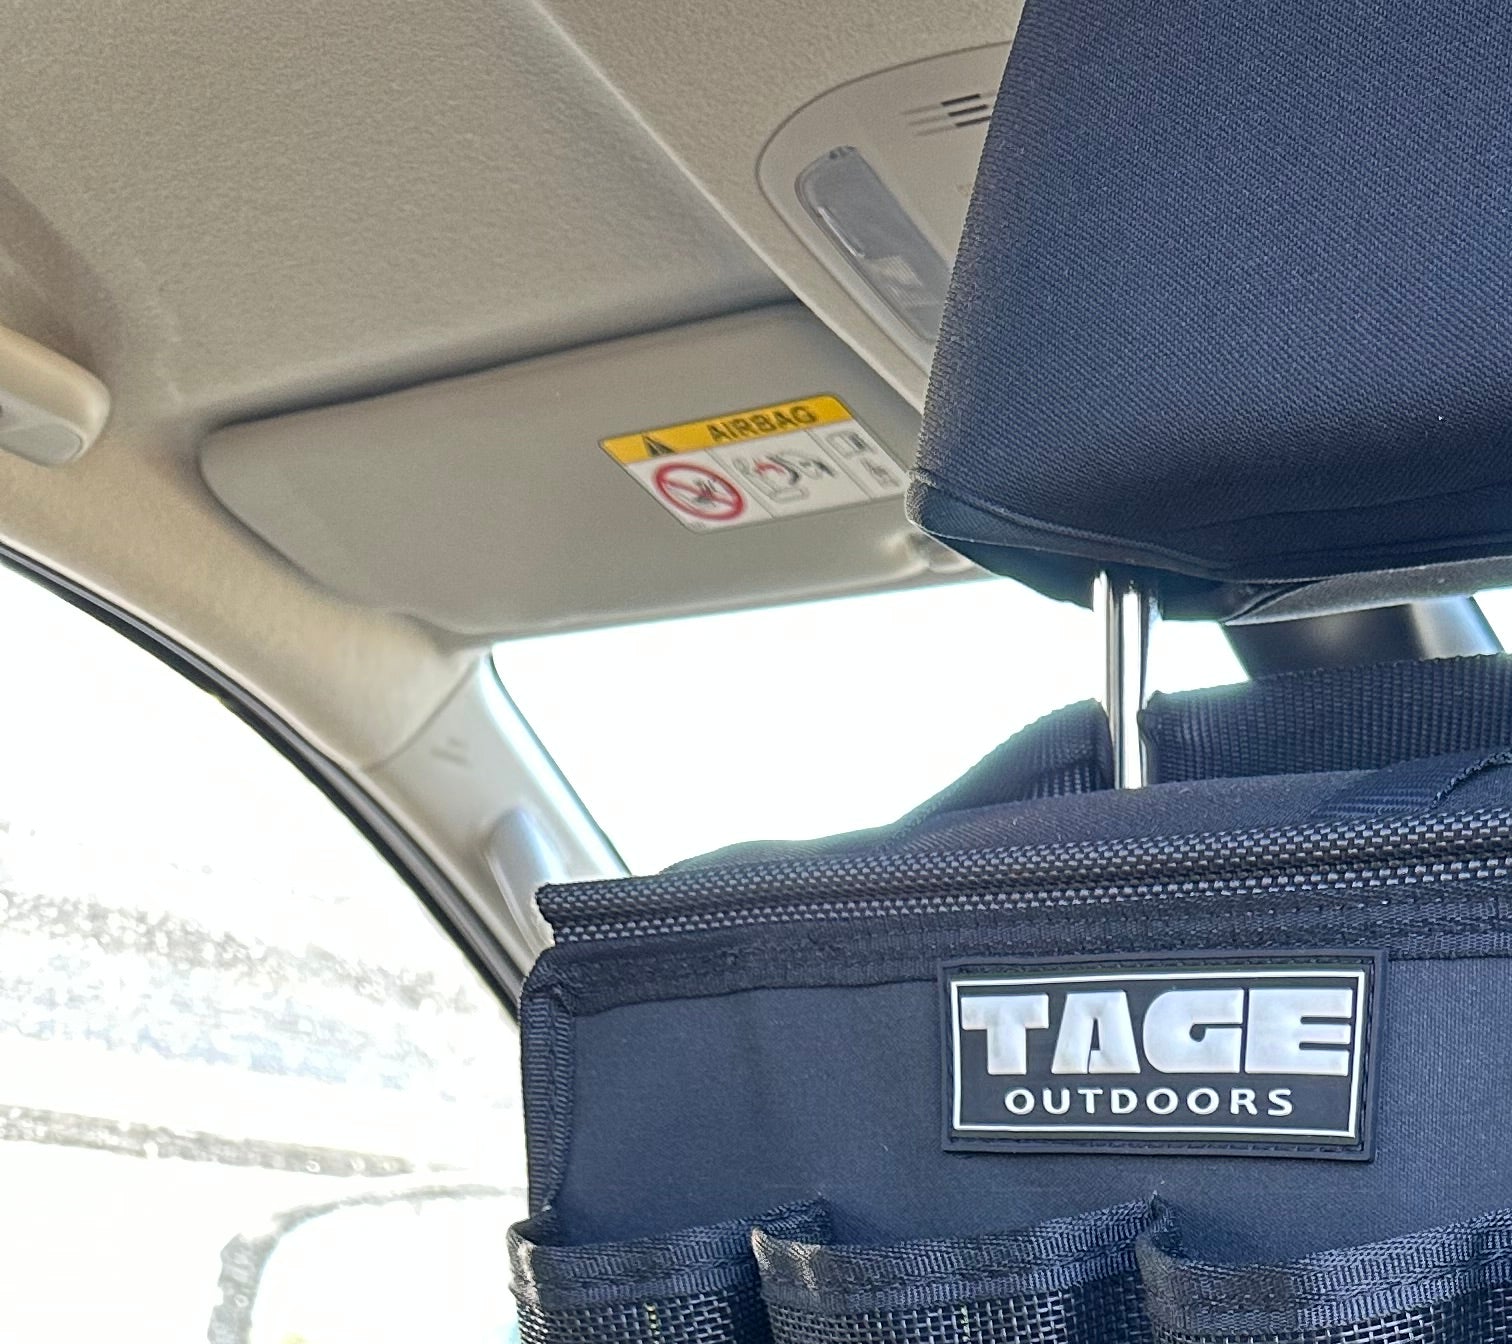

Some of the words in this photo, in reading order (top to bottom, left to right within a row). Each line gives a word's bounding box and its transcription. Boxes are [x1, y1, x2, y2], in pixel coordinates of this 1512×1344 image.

[707, 405, 818, 443] AIRBAG
[960, 987, 1353, 1076] TAGE
[1004, 1087, 1294, 1117] OUTDOORS
